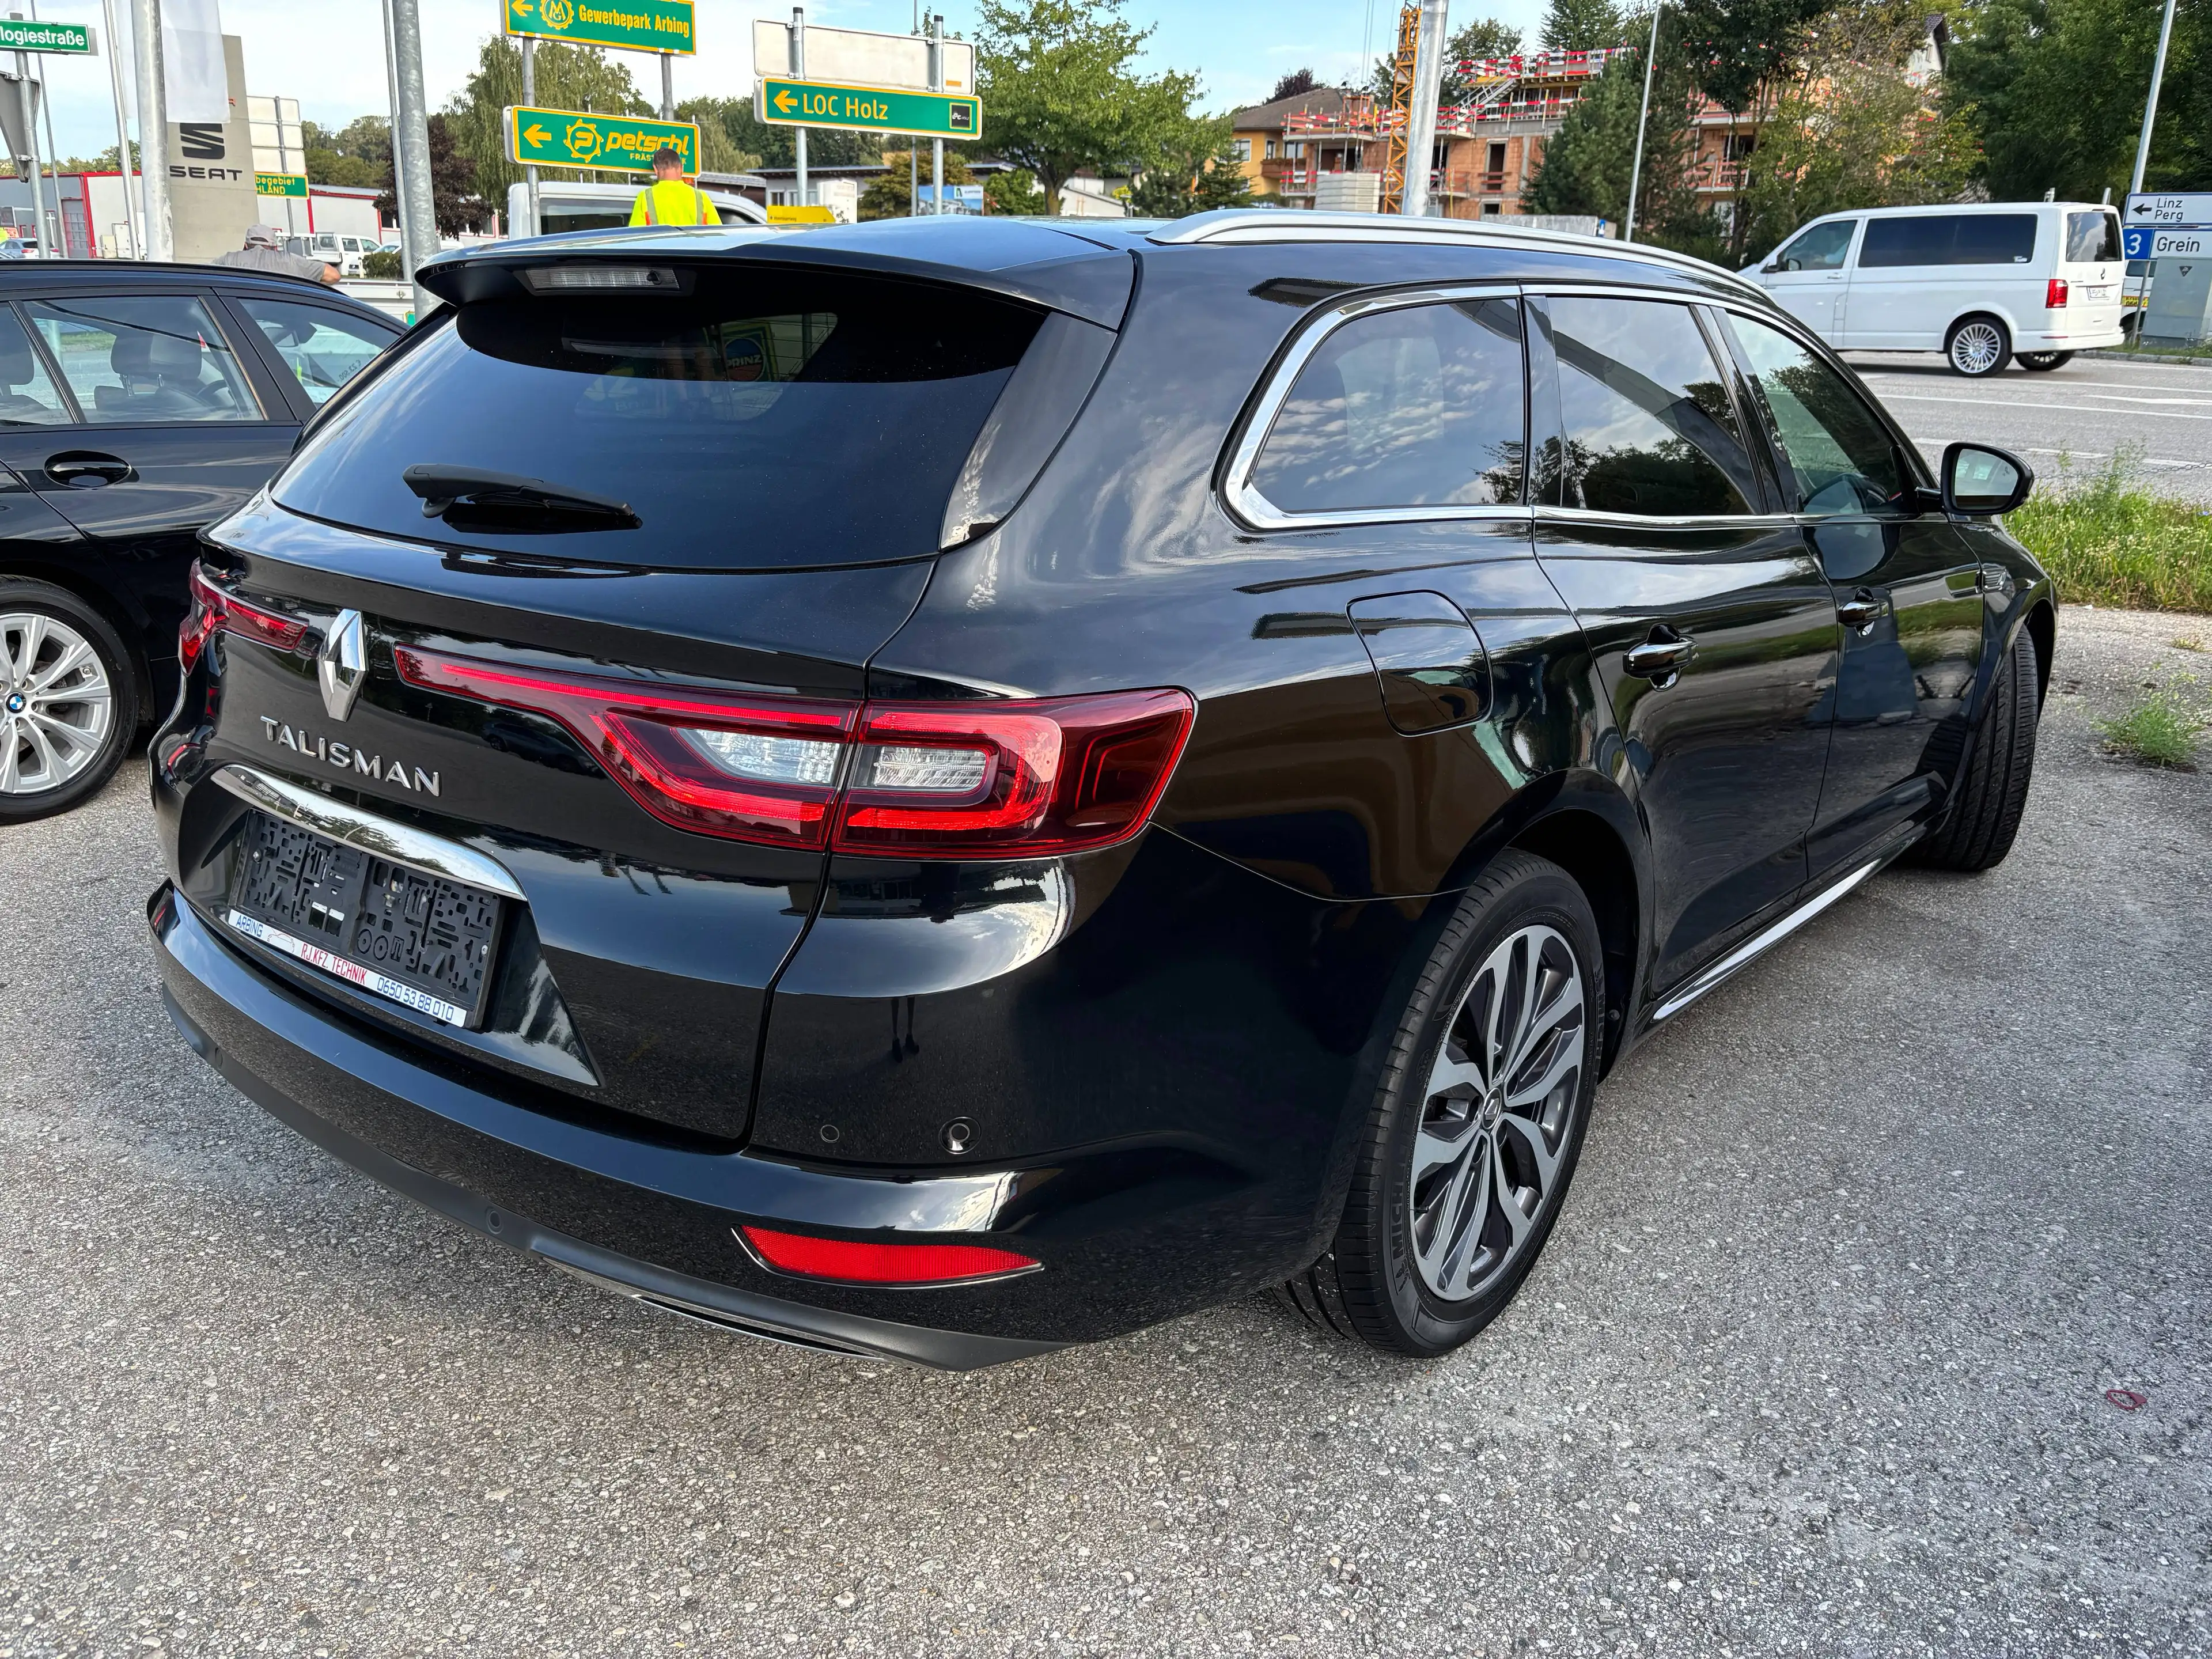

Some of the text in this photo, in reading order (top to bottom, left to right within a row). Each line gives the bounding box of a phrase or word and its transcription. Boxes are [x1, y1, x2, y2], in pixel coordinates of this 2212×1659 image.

[578, 4, 690, 37] Gewerbepark Arbing
[0, 25, 85, 46] logiestraße
[803, 93, 888, 120] LOC Holz
[605, 131, 689, 156] petschl
[169, 165, 243, 181] SEAT
[2157, 198, 2183, 208] Linz
[2154, 210, 2183, 222] Perg
[2127, 233, 2142, 255] 3
[2157, 237, 2200, 252] Grein
[260, 715, 440, 797] TALISMAN
[236, 914, 263, 938] ARBING
[331, 956, 368, 985] TECHNIK
[377, 977, 454, 1021] 0650 53 88 010
